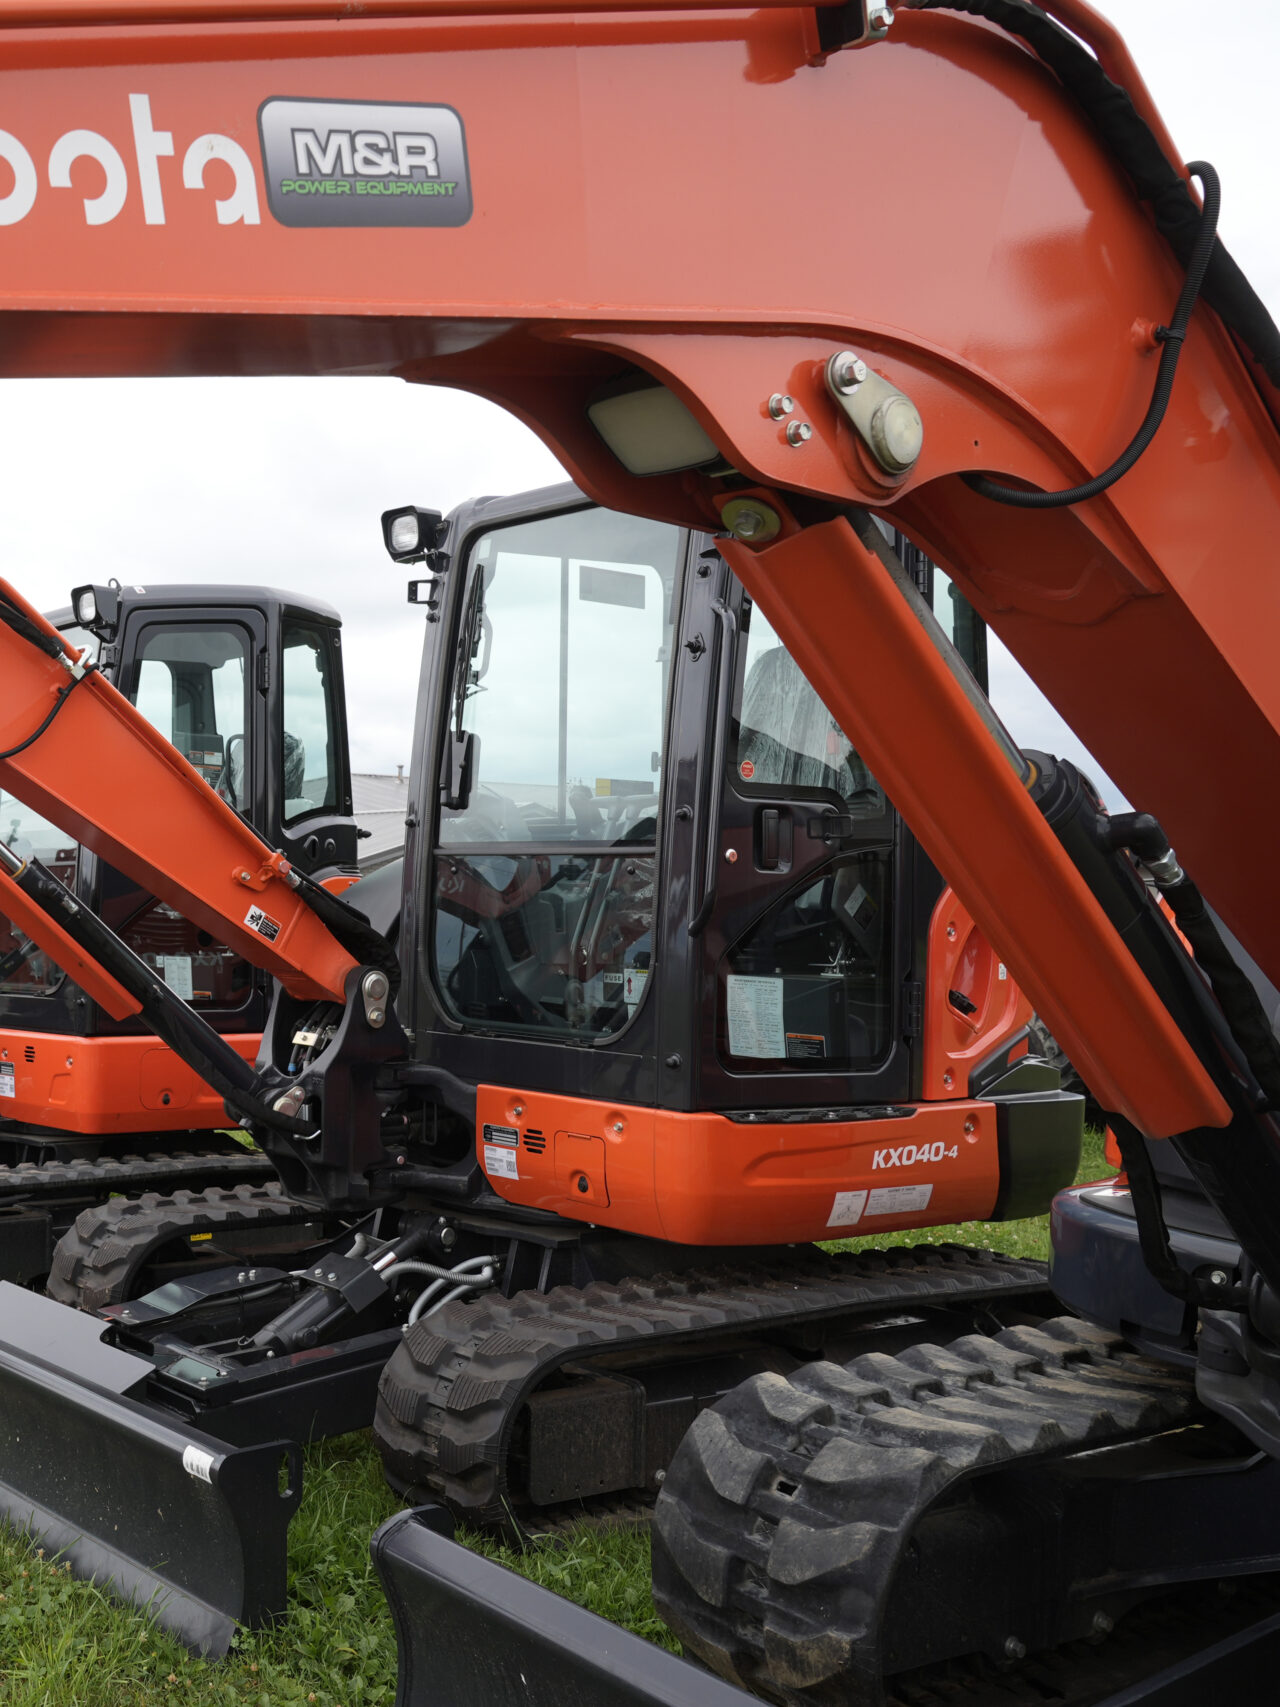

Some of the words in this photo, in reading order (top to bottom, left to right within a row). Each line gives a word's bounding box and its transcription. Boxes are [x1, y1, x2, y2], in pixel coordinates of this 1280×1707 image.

[291, 129, 440, 178] M&R
[281, 180, 351, 195] POWER
[355, 181, 457, 196] EQUIPMENT
[872, 1141, 958, 1170] KX040-4
